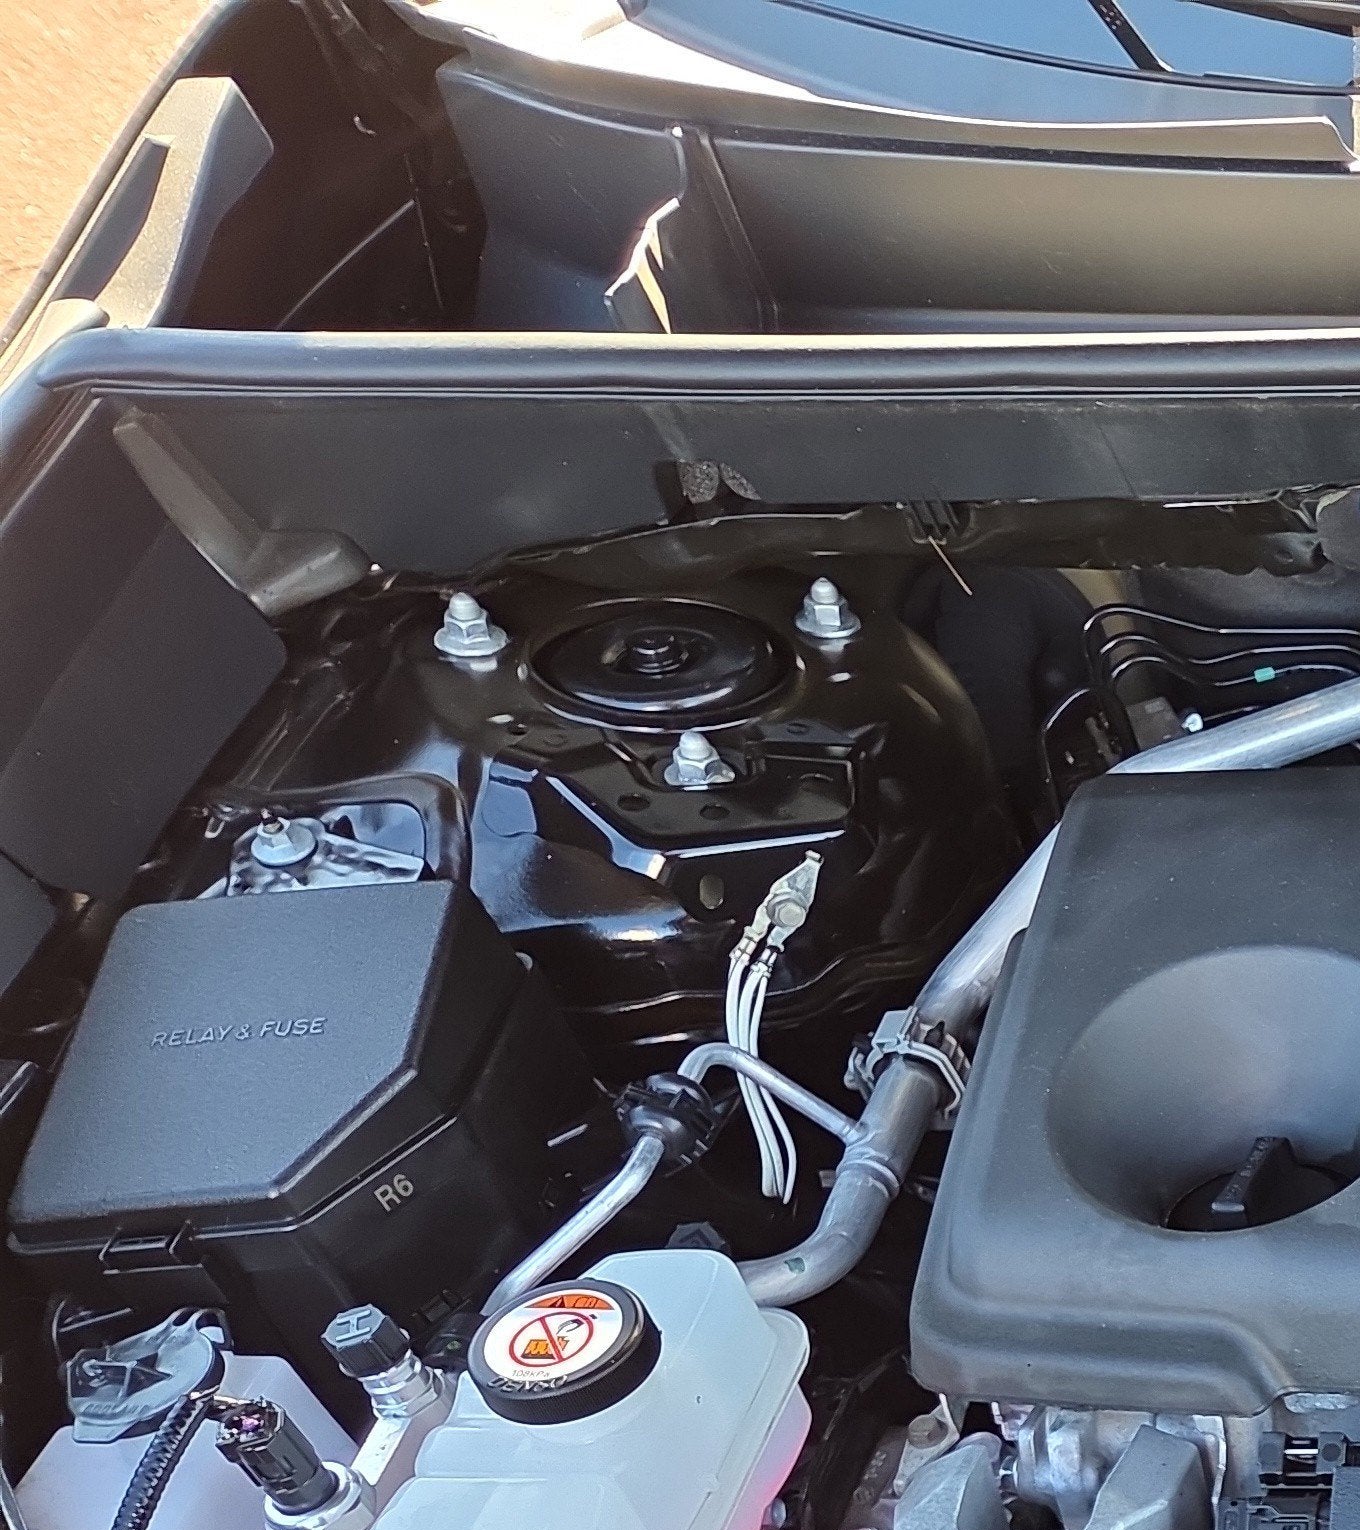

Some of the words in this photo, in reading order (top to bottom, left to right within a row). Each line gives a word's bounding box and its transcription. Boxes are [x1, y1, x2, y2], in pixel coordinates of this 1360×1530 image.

[151, 1025, 233, 1048] RELAY
[235, 1023, 252, 1040] &
[259, 1016, 328, 1038] FUSE
[373, 1173, 415, 1213] R6
[487, 1374, 568, 1394] DENSO
